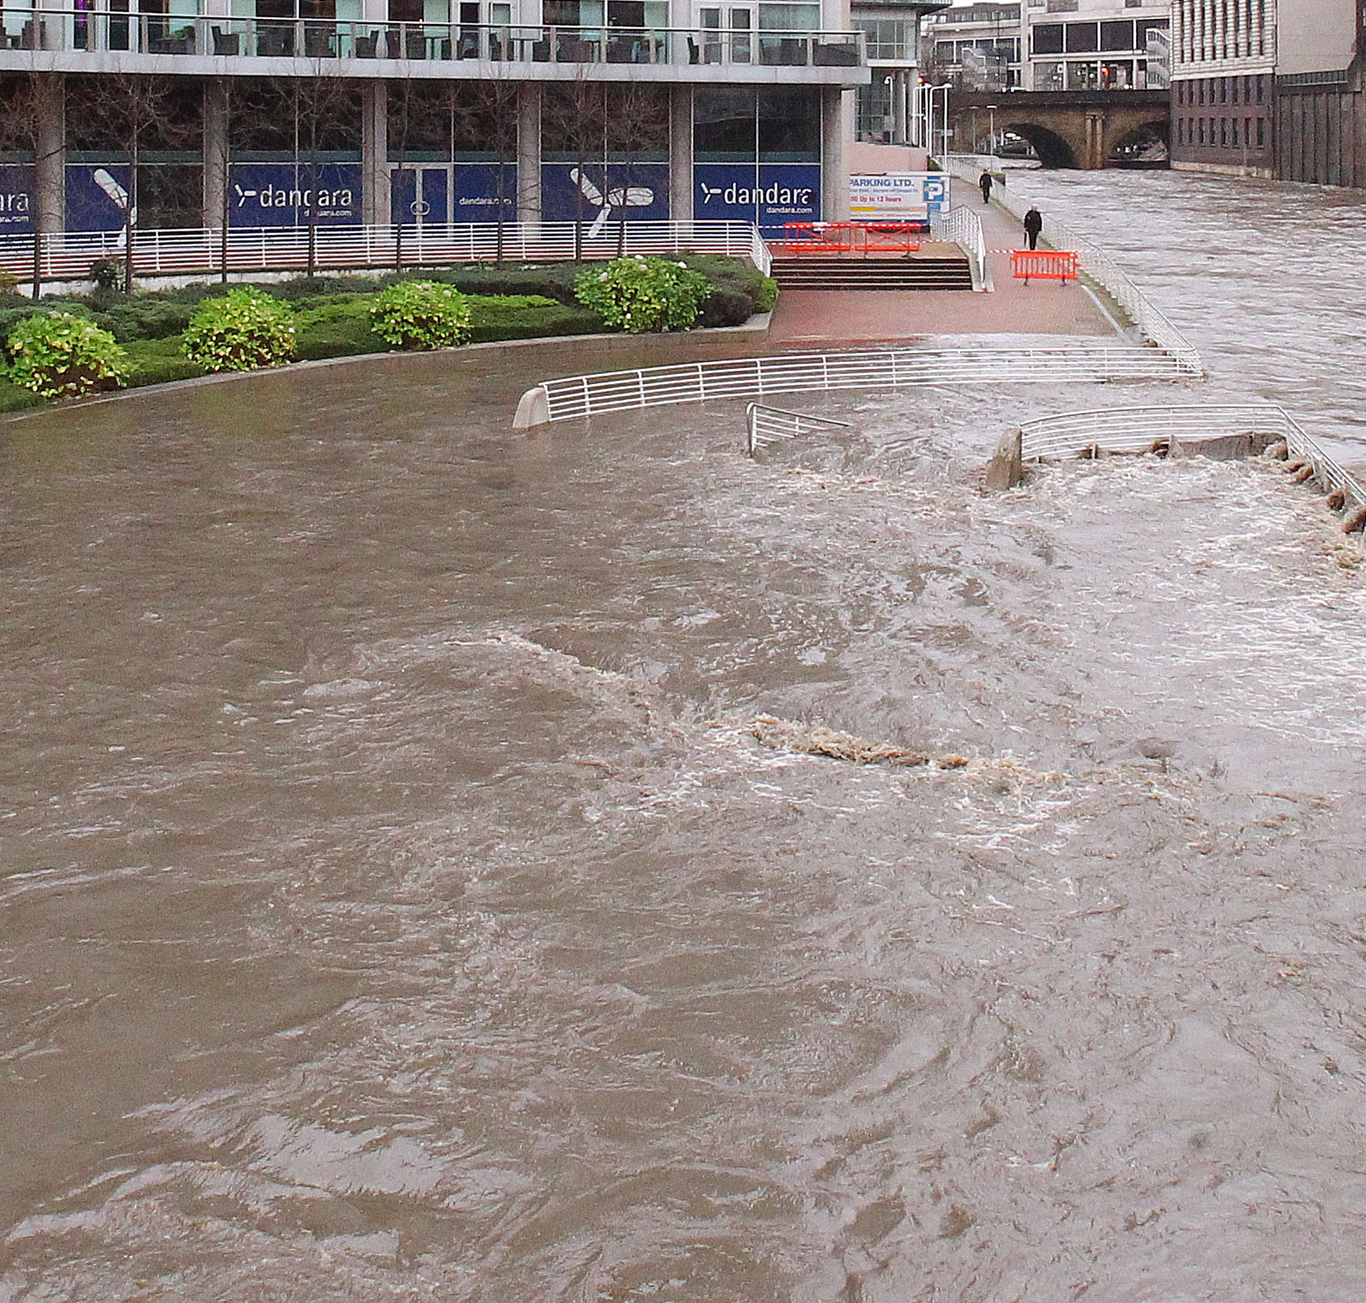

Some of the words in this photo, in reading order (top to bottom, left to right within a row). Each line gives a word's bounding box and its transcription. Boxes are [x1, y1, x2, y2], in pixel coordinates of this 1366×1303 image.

[893, 179, 915, 187] LTD.
[724, 182, 812, 205] dandara
[459, 197, 512, 206] dandara.cm
[303, 209, 353, 218] dara.com
[766, 206, 813, 214] dandara.com
